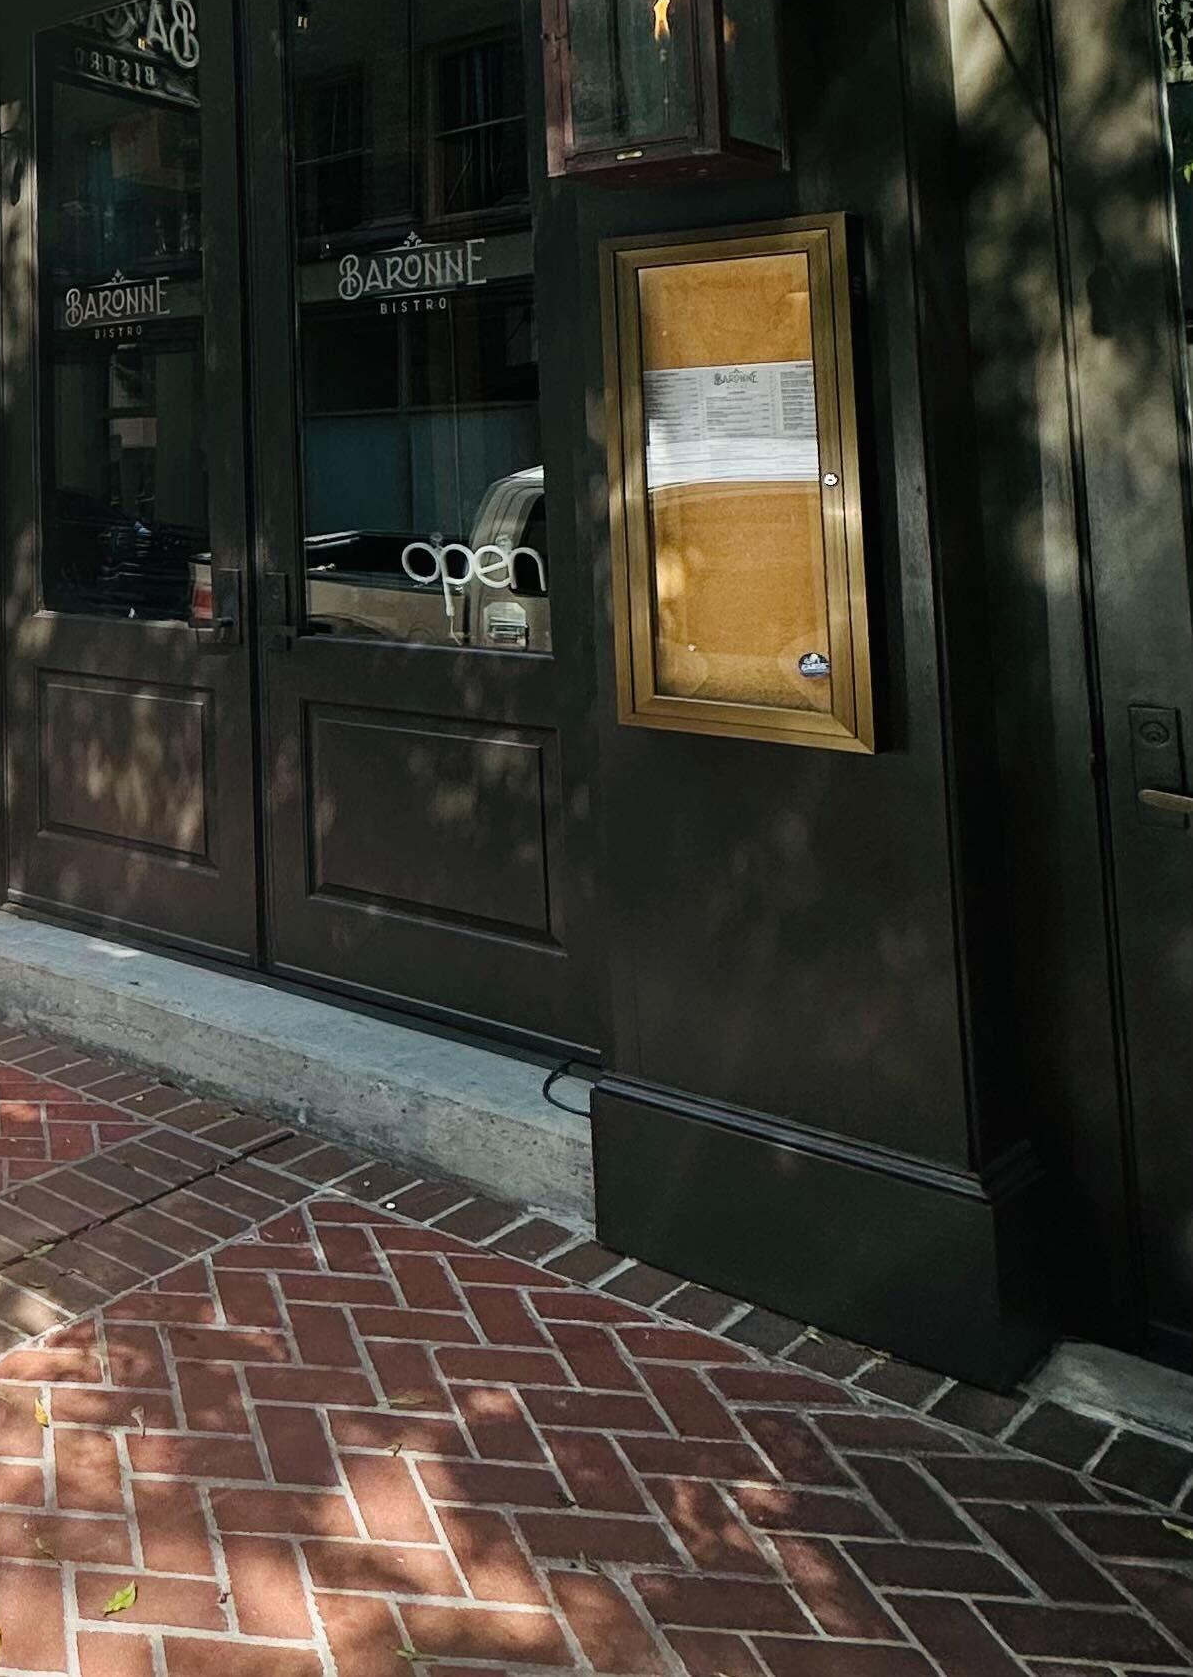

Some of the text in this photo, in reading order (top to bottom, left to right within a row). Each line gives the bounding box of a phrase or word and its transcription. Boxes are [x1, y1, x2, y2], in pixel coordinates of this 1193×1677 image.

[338, 238, 488, 301] BARONNE
[66, 276, 171, 327] BARONNE
[380, 297, 447, 314] BISTRO
[94, 325, 143, 339] BISTRO
[401, 541, 547, 617] open
